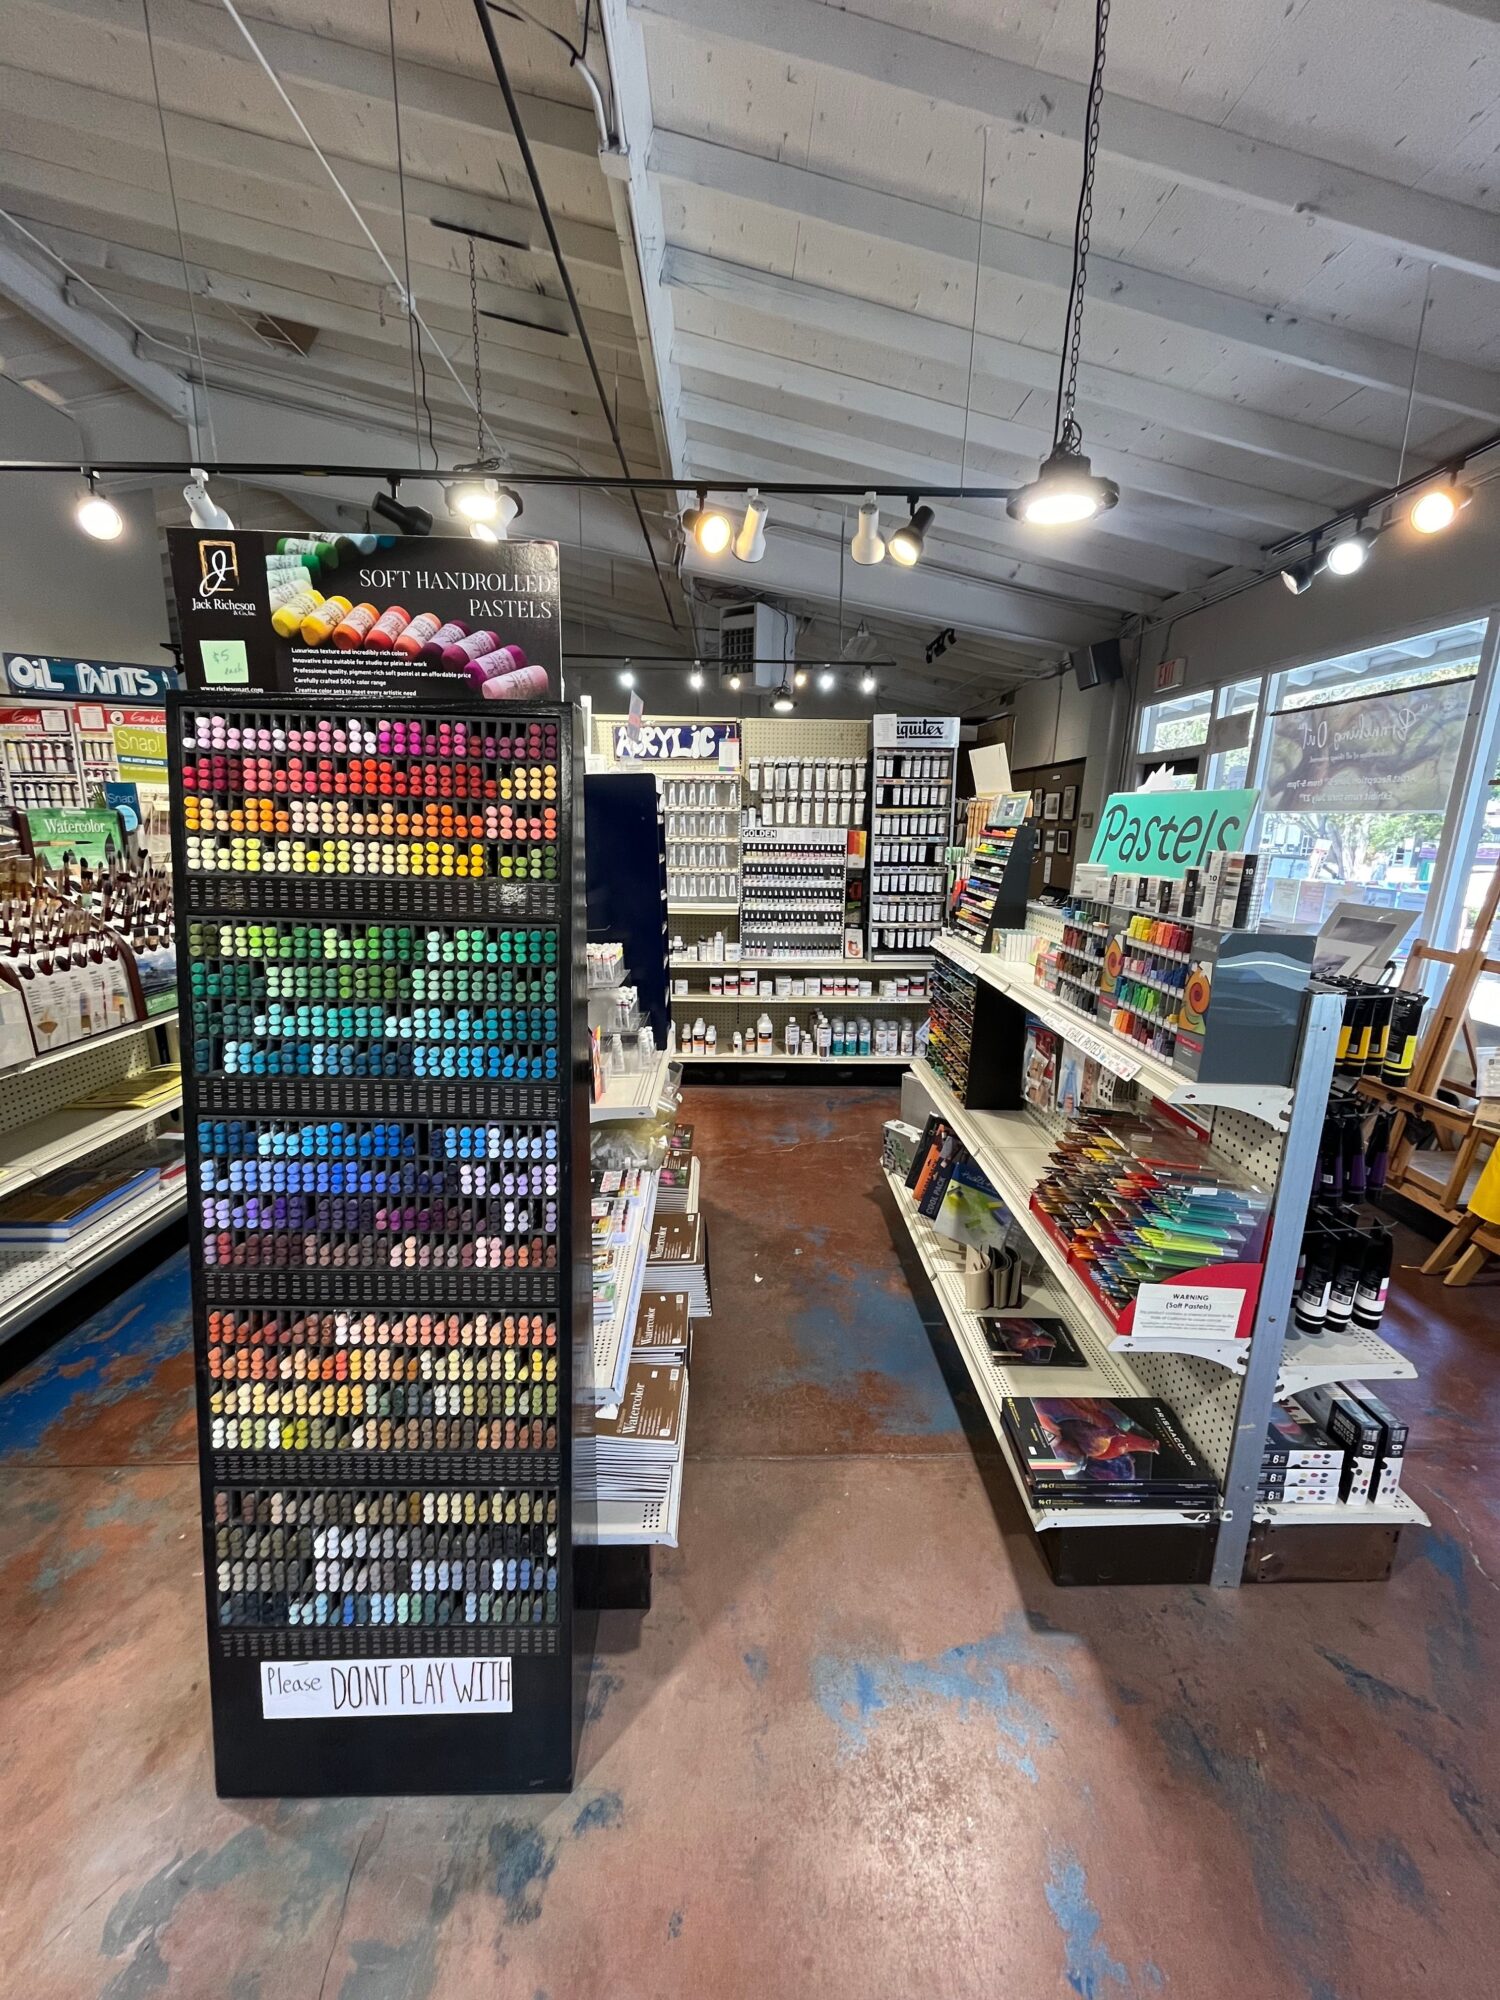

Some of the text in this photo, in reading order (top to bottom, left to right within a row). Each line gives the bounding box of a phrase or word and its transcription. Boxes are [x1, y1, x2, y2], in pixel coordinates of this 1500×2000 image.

[359, 569, 551, 593] SOFT HANDROLLED
[192, 598, 256, 611] Jack Richeson
[469, 599, 552, 619] PASTELS
[896, 719, 944, 739] iquitex
[117, 730, 161, 754] Snap!
[44, 818, 105, 834] Watercolor
[743, 829, 777, 838] GOLDEN
[1097, 804, 1240, 866] Pastels
[926, 1177, 947, 1215] COOL PACK
[1173, 1293, 1209, 1301] WARNING
[1184, 1303, 1212, 1311] Pastels)
[641, 1307, 656, 1346] Watercolor
[622, 1382, 645, 1434] Watercolor
[1154, 1407, 1197, 1466] PRISMACOLOR
[1273, 1455, 1279, 1464] 6
[1270, 1473, 1276, 1482] 6
[1268, 1491, 1274, 1500] 6
[267, 1661, 512, 1710] Please DONT PLAY WITH
